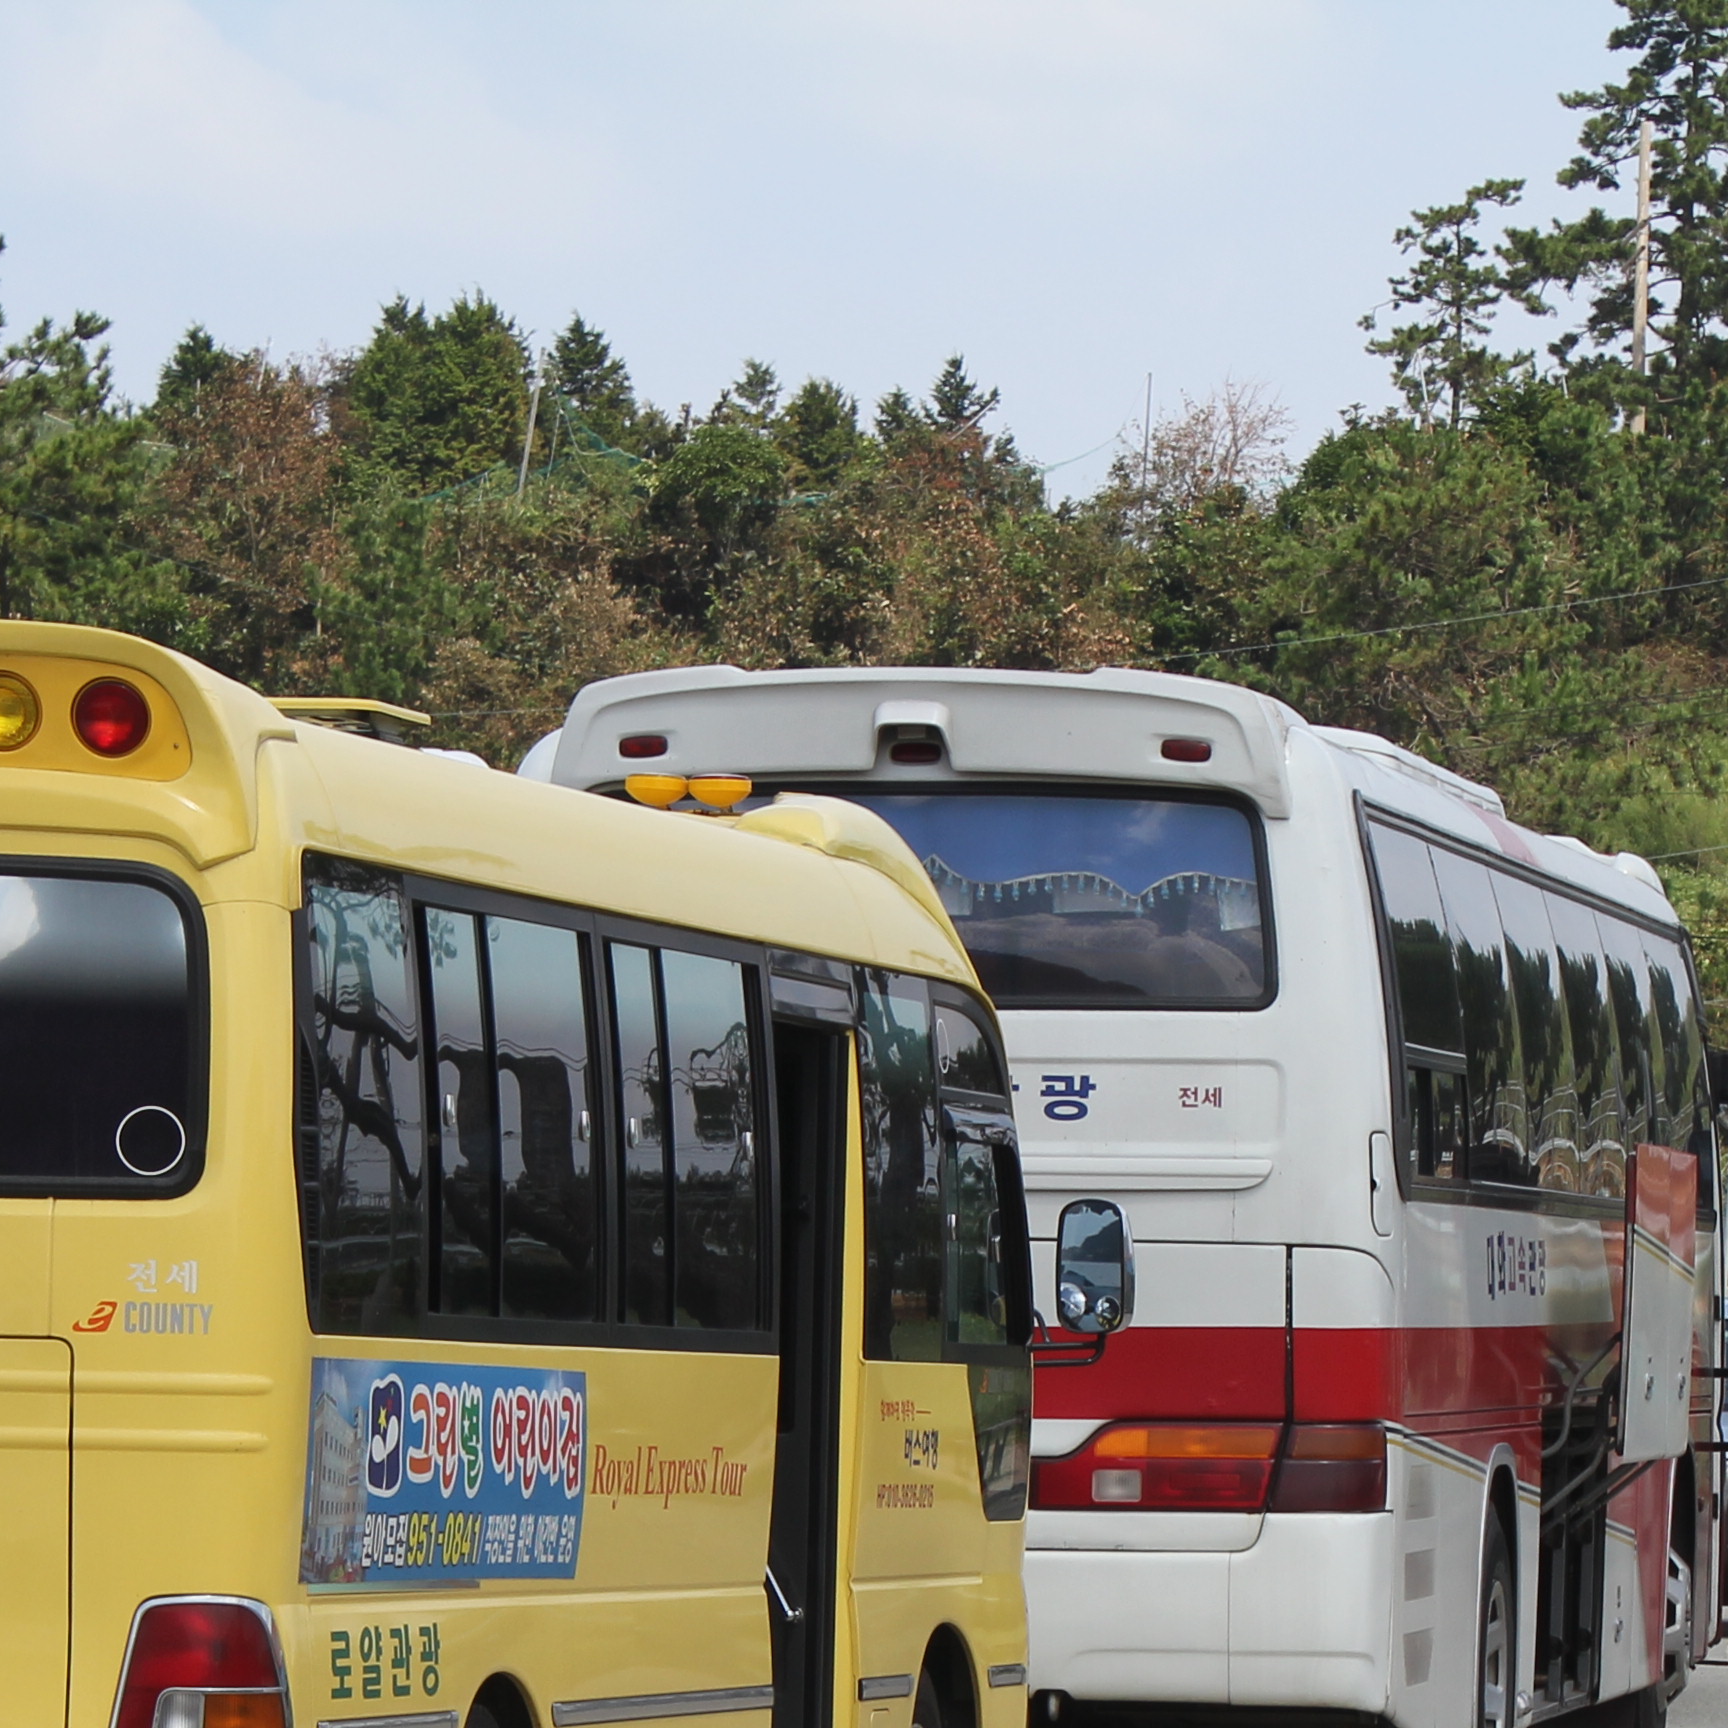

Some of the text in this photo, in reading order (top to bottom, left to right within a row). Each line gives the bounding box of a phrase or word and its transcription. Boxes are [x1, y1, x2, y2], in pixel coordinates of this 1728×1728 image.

[1178, 1086, 1223, 1109] 전세
[127, 1259, 199, 1294] 전세
[124, 1301, 213, 1334] COUNTY
[406, 1381, 583, 1499] 그린별 어린이집
[904, 1428, 938, 1470] 버스여행
[591, 1444, 747, 1510] Royal Express Tour
[330, 1622, 441, 1700] 로얄관광
